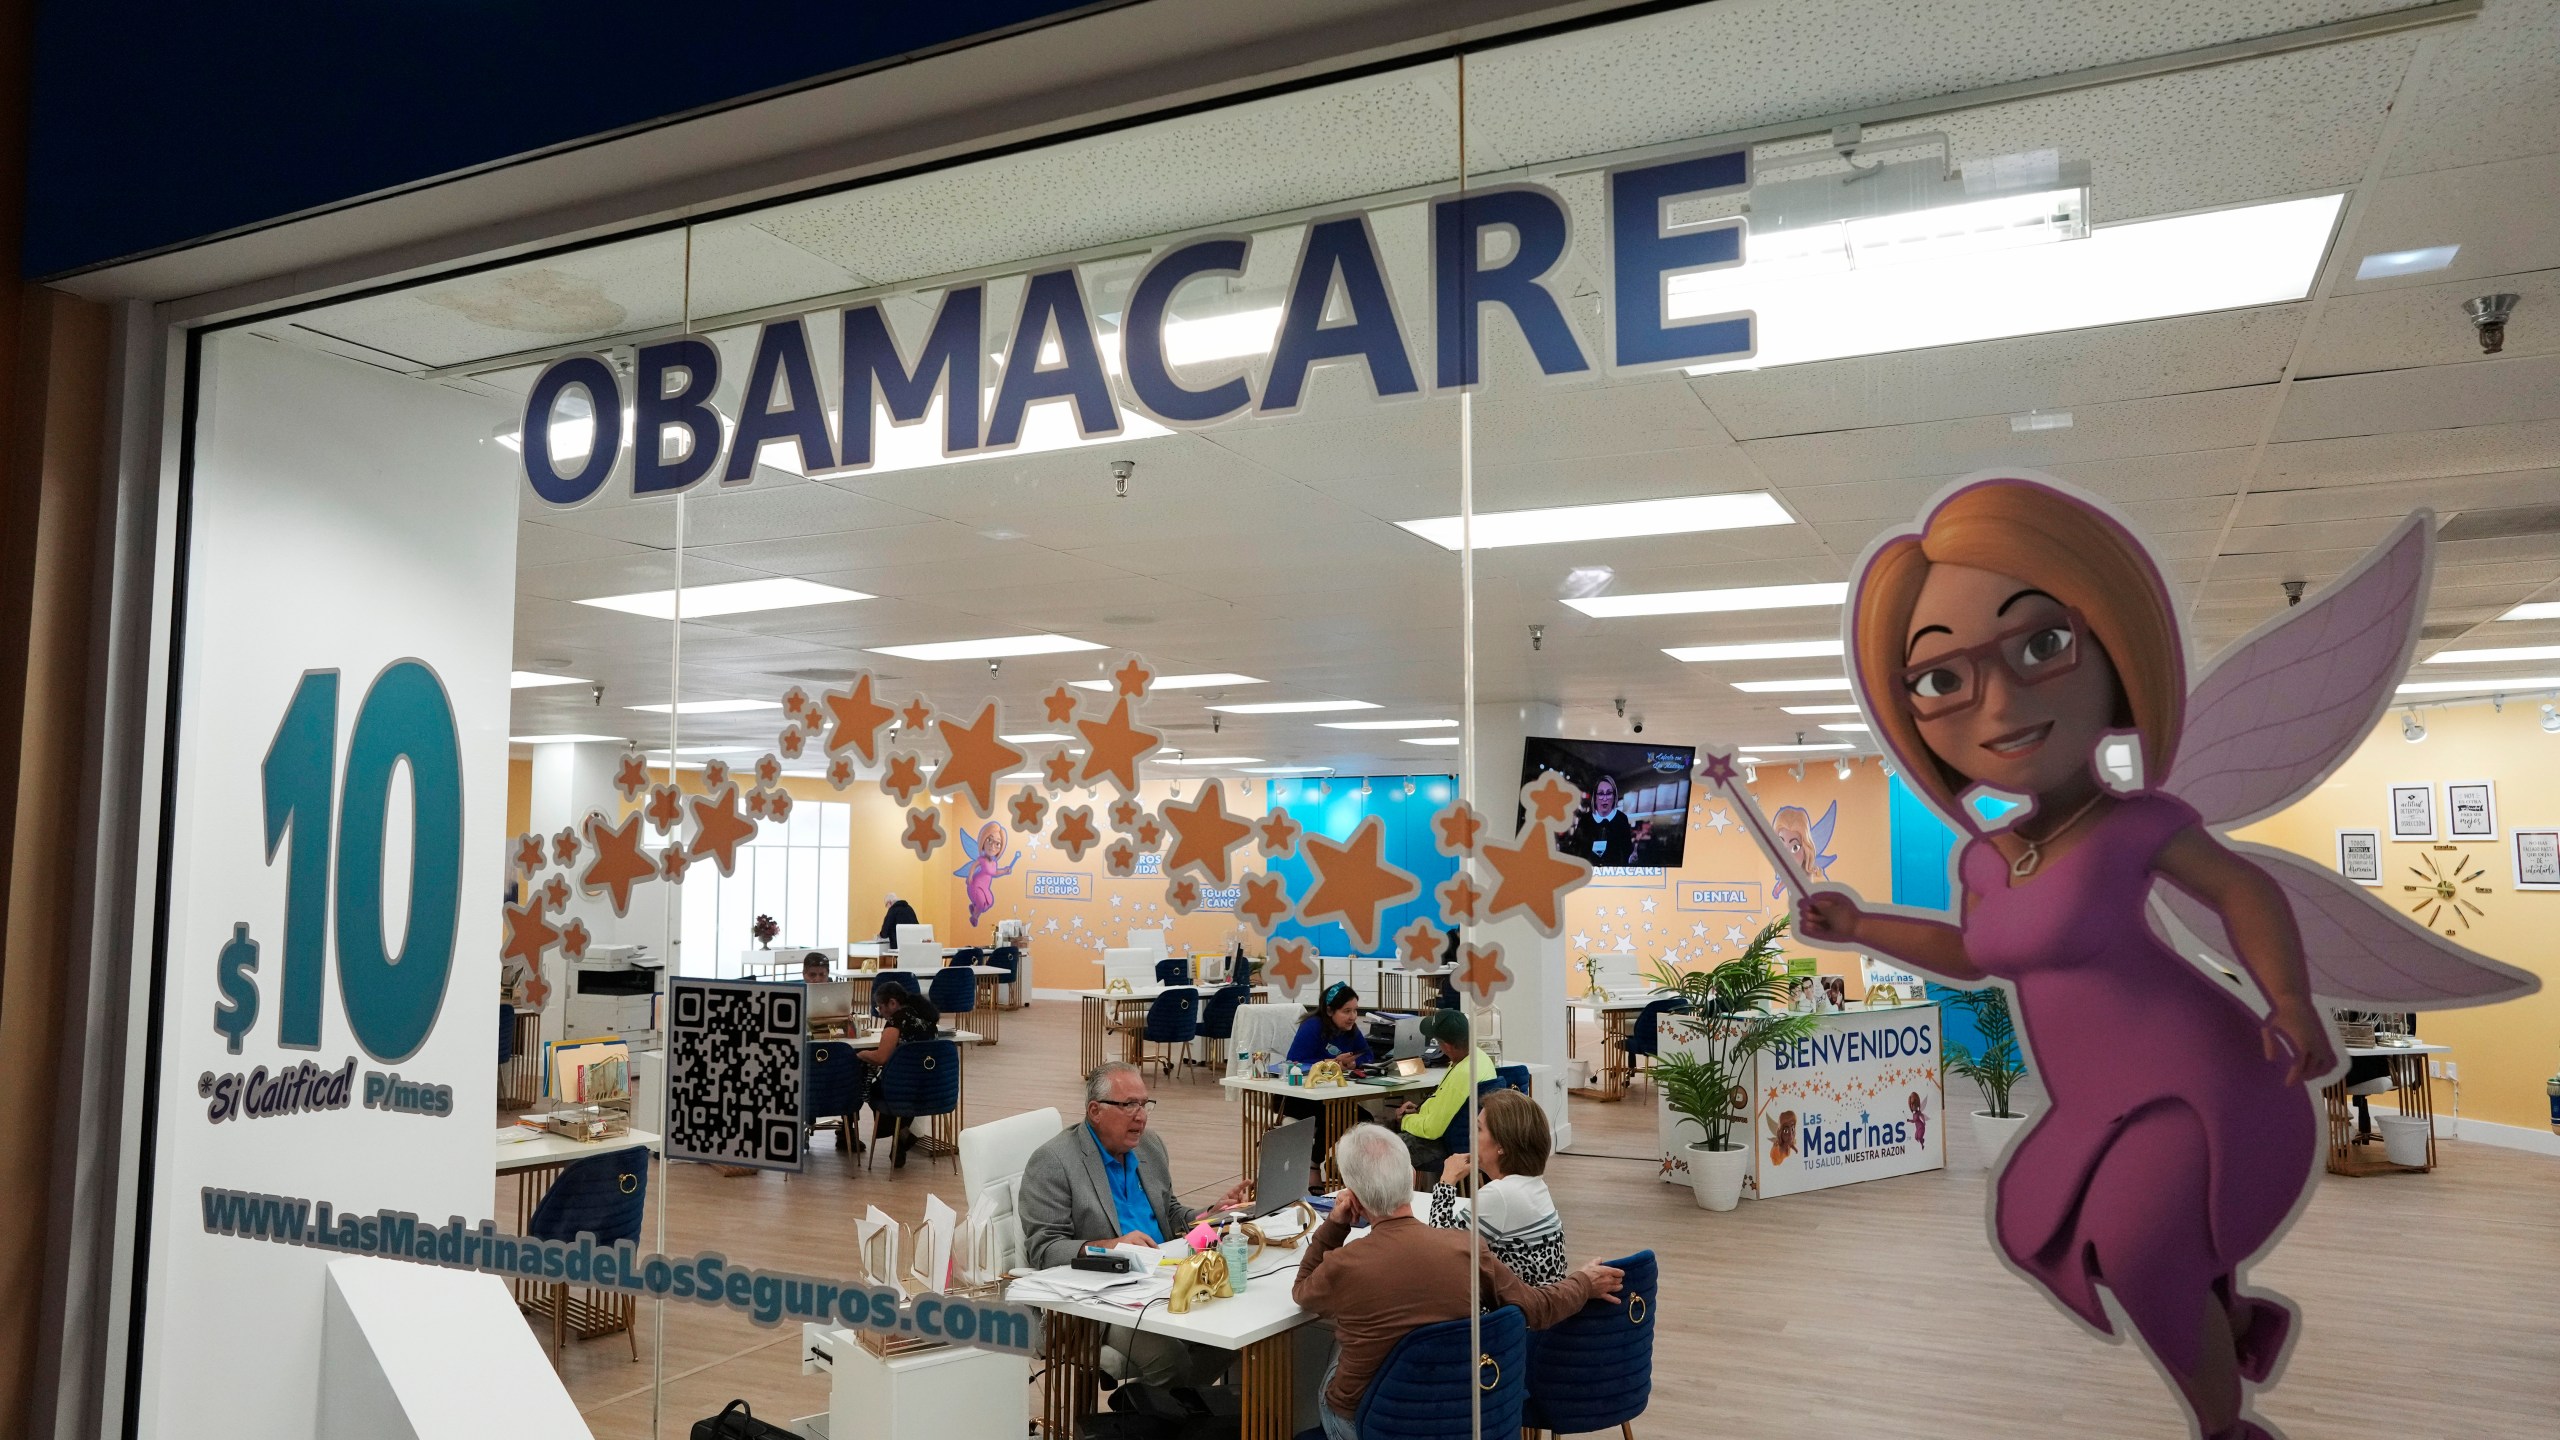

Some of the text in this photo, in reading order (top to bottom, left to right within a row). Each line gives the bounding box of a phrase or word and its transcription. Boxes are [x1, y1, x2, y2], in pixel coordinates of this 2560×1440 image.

[521, 147, 1755, 508] OBAMACARE
[1592, 866, 1662, 876] AMACARE
[1036, 876, 1078, 886] SEGUROS
[1034, 886, 1080, 895] DE GRUPO
[1200, 888, 1241, 898] EGUROS
[1693, 891, 1747, 902] DENTAL
[1207, 898, 1237, 908] CANC
[1775, 1024, 1932, 1070] BIENVENIDOS
[245, 1061, 355, 1114] Califica!
[366, 1076, 450, 1112] P/mes
[1803, 1112, 1822, 1126] Las
[1804, 1160, 1814, 1170] TU
[1845, 1150, 1880, 1164] NUESTRA
[1881, 1145, 1906, 1158] RAZON
